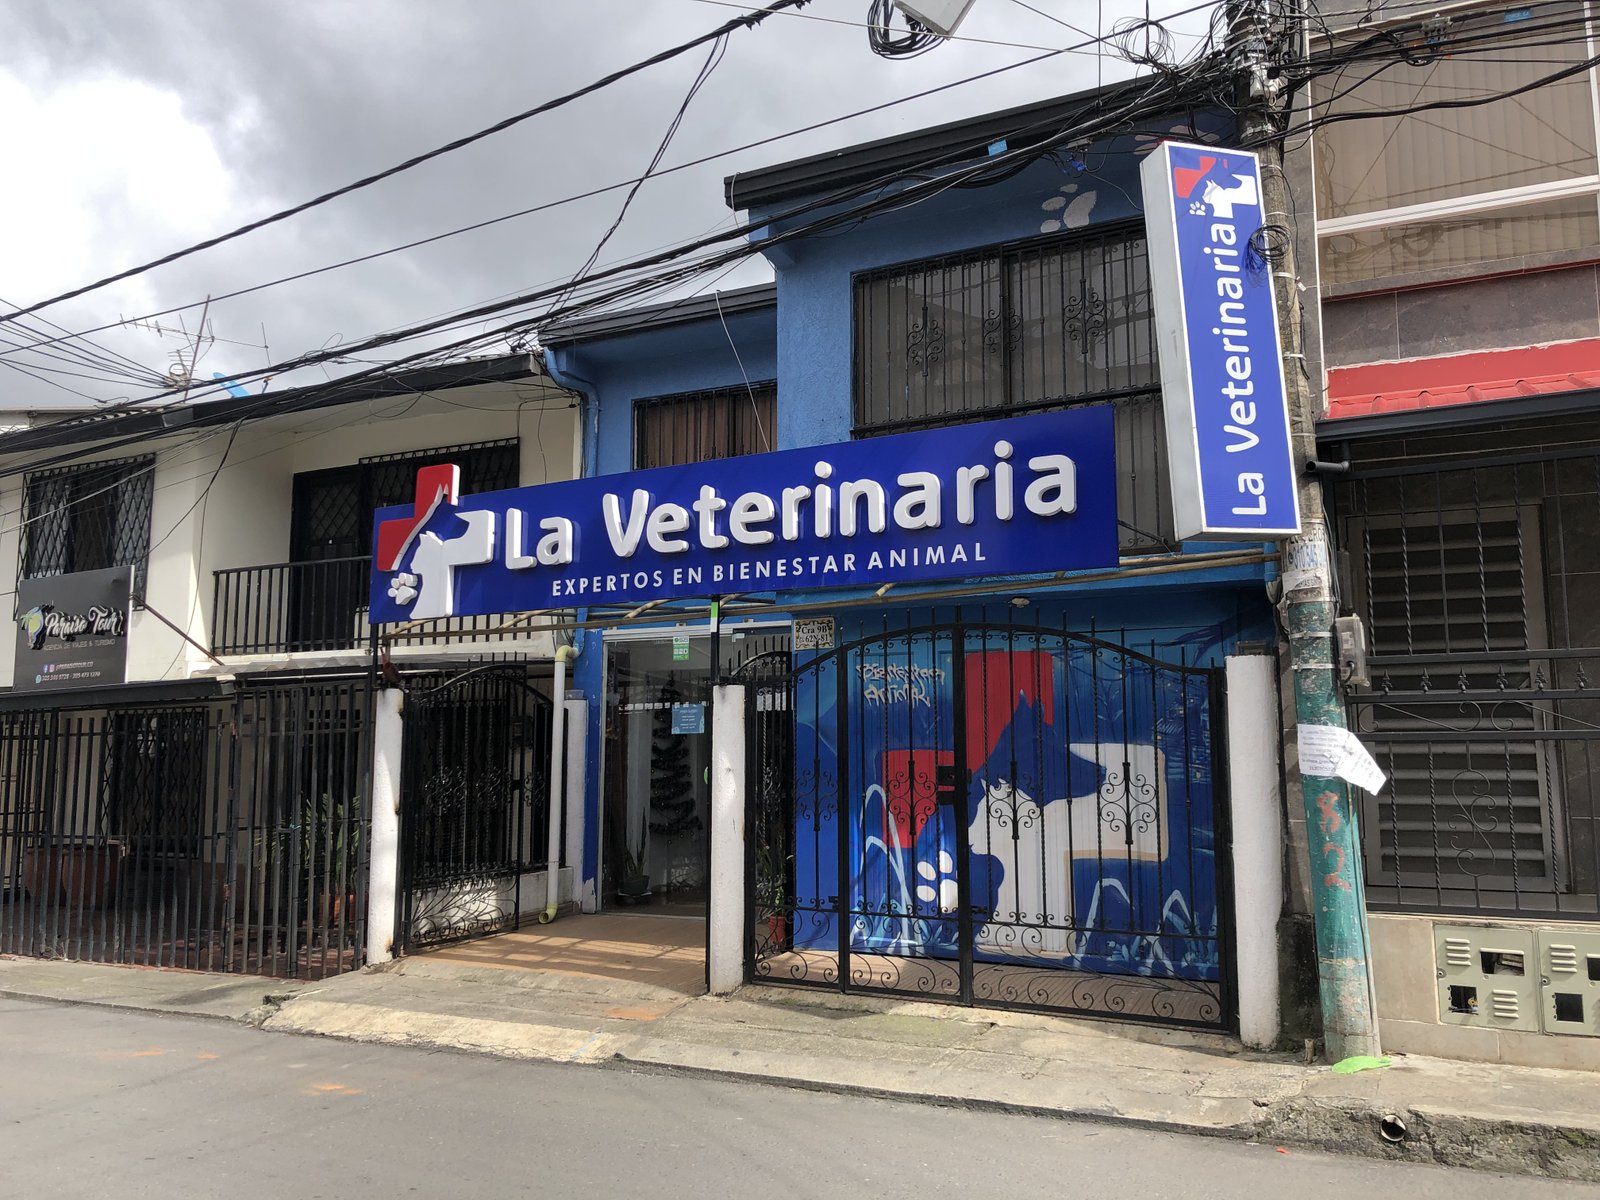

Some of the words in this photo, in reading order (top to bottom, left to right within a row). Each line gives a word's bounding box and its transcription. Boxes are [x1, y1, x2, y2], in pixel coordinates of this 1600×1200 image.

[1204, 223, 1260, 453] Veterinaria
[505, 507, 574, 570] La
[602, 440, 1077, 558] Veterinaria
[1232, 472, 1267, 515] La
[552, 571, 663, 597] EXPERTOS
[673, 567, 702, 586] EN
[713, 553, 857, 582] BIENESTAR
[867, 542, 986, 570] ANIMAL
[801, 626, 815, 634] Cra
